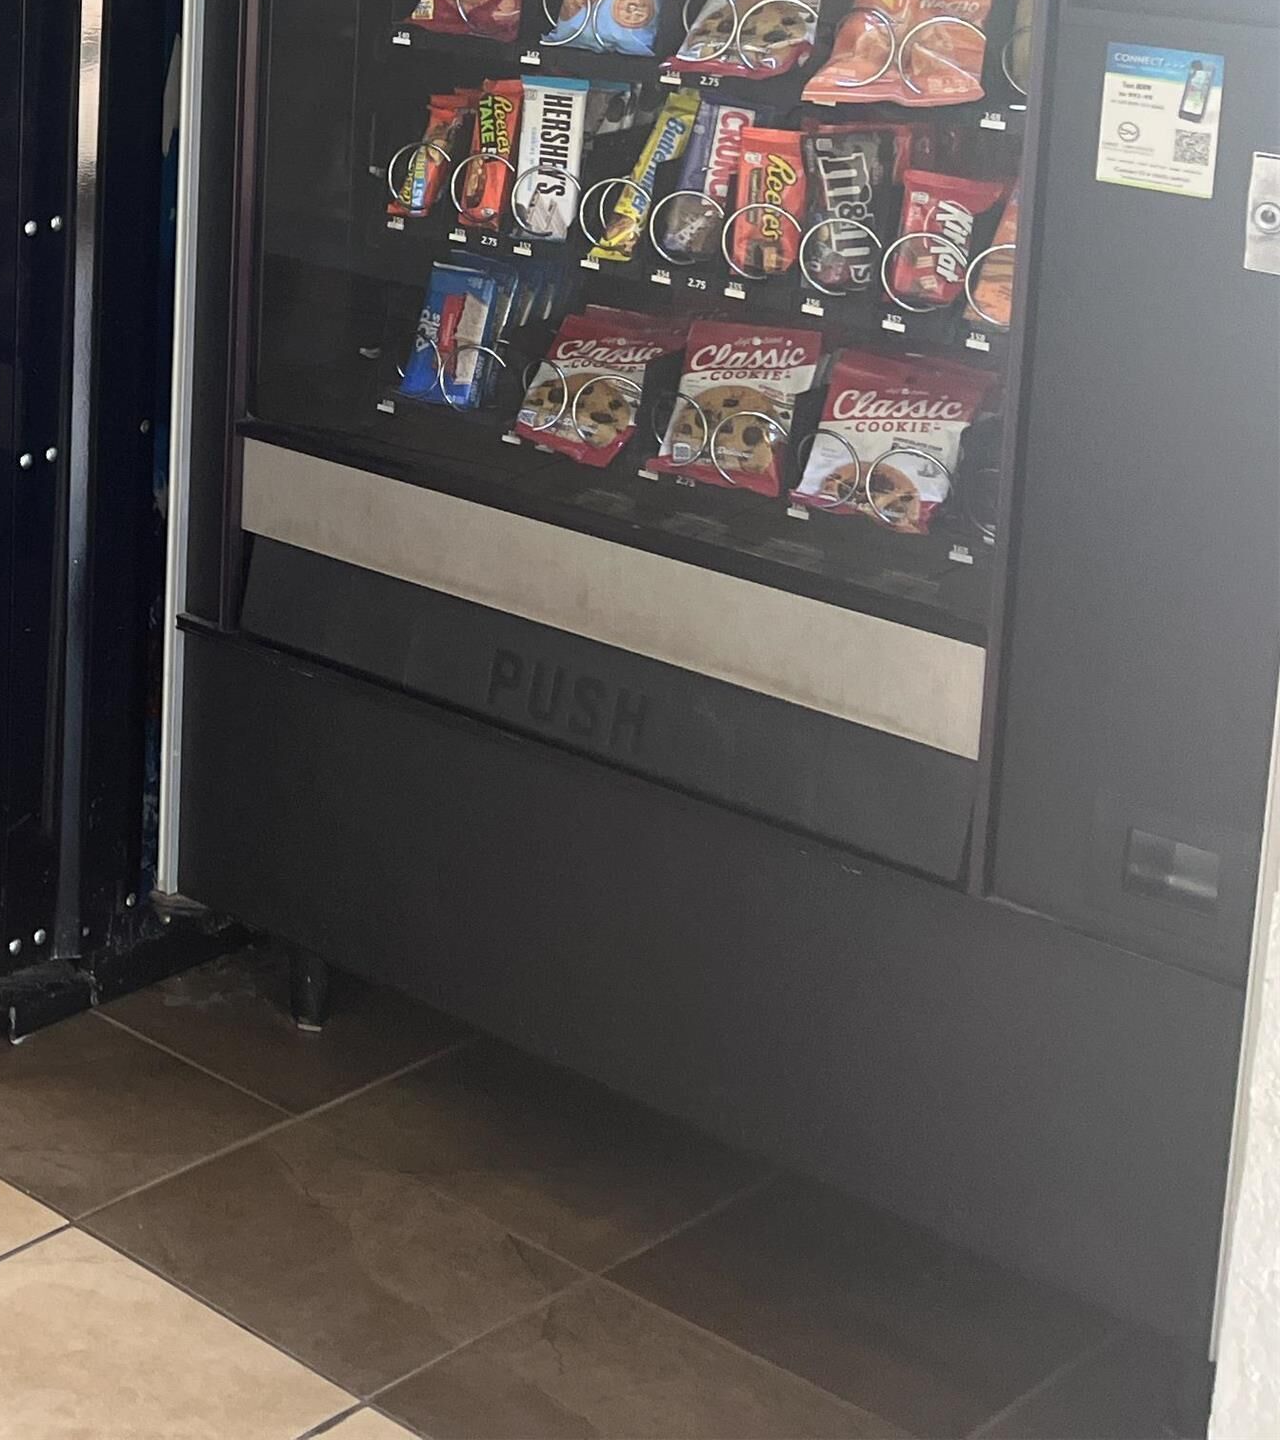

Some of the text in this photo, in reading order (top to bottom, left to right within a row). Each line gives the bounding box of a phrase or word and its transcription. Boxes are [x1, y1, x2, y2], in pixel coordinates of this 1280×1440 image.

[700, 76, 720, 86] 2.75
[480, 96, 496, 147] TAKE
[481, 235, 498, 246] 2.75
[687, 277, 706, 289] 2.75
[556, 339, 664, 363] Classic
[691, 339, 807, 372] Classic
[833, 389, 963, 420] Classic
[488, 648, 648, 754] PUSH
